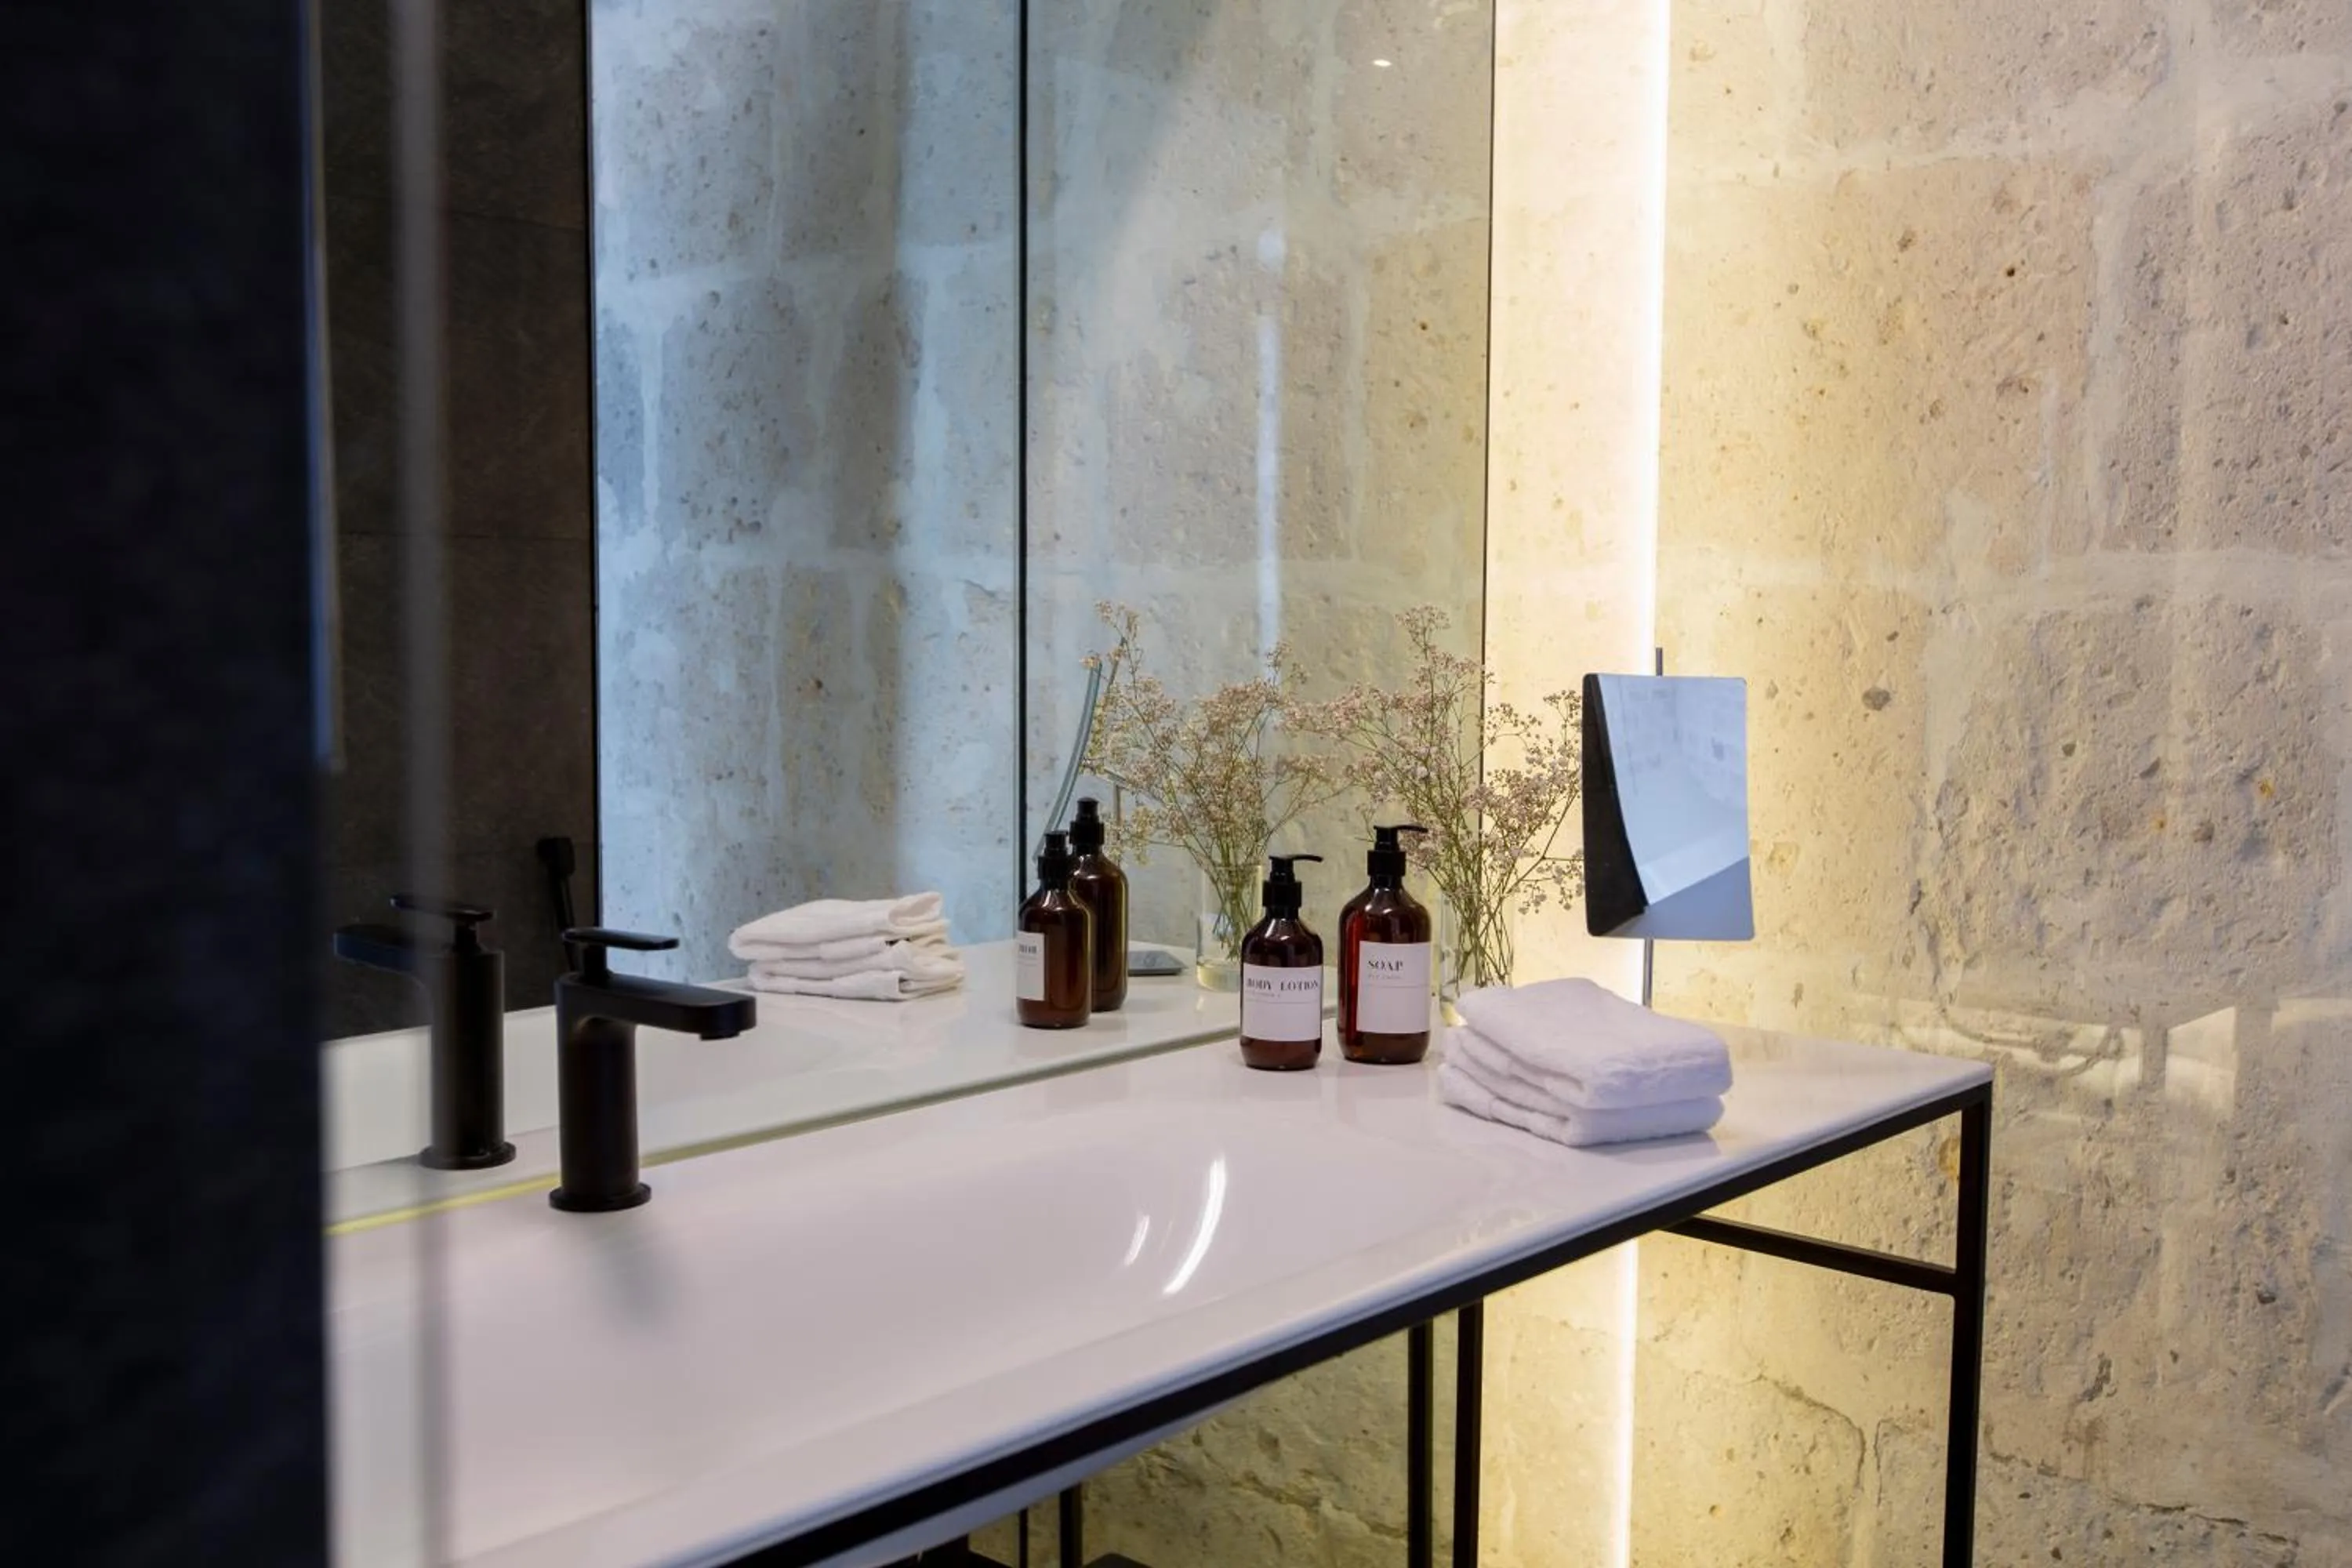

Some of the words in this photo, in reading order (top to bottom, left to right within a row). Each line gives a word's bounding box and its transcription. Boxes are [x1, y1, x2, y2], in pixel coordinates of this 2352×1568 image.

[1367, 960, 1403, 972] SOAP
[1247, 978, 1272, 990] BODY
[1280, 978, 1319, 991] LOTION
